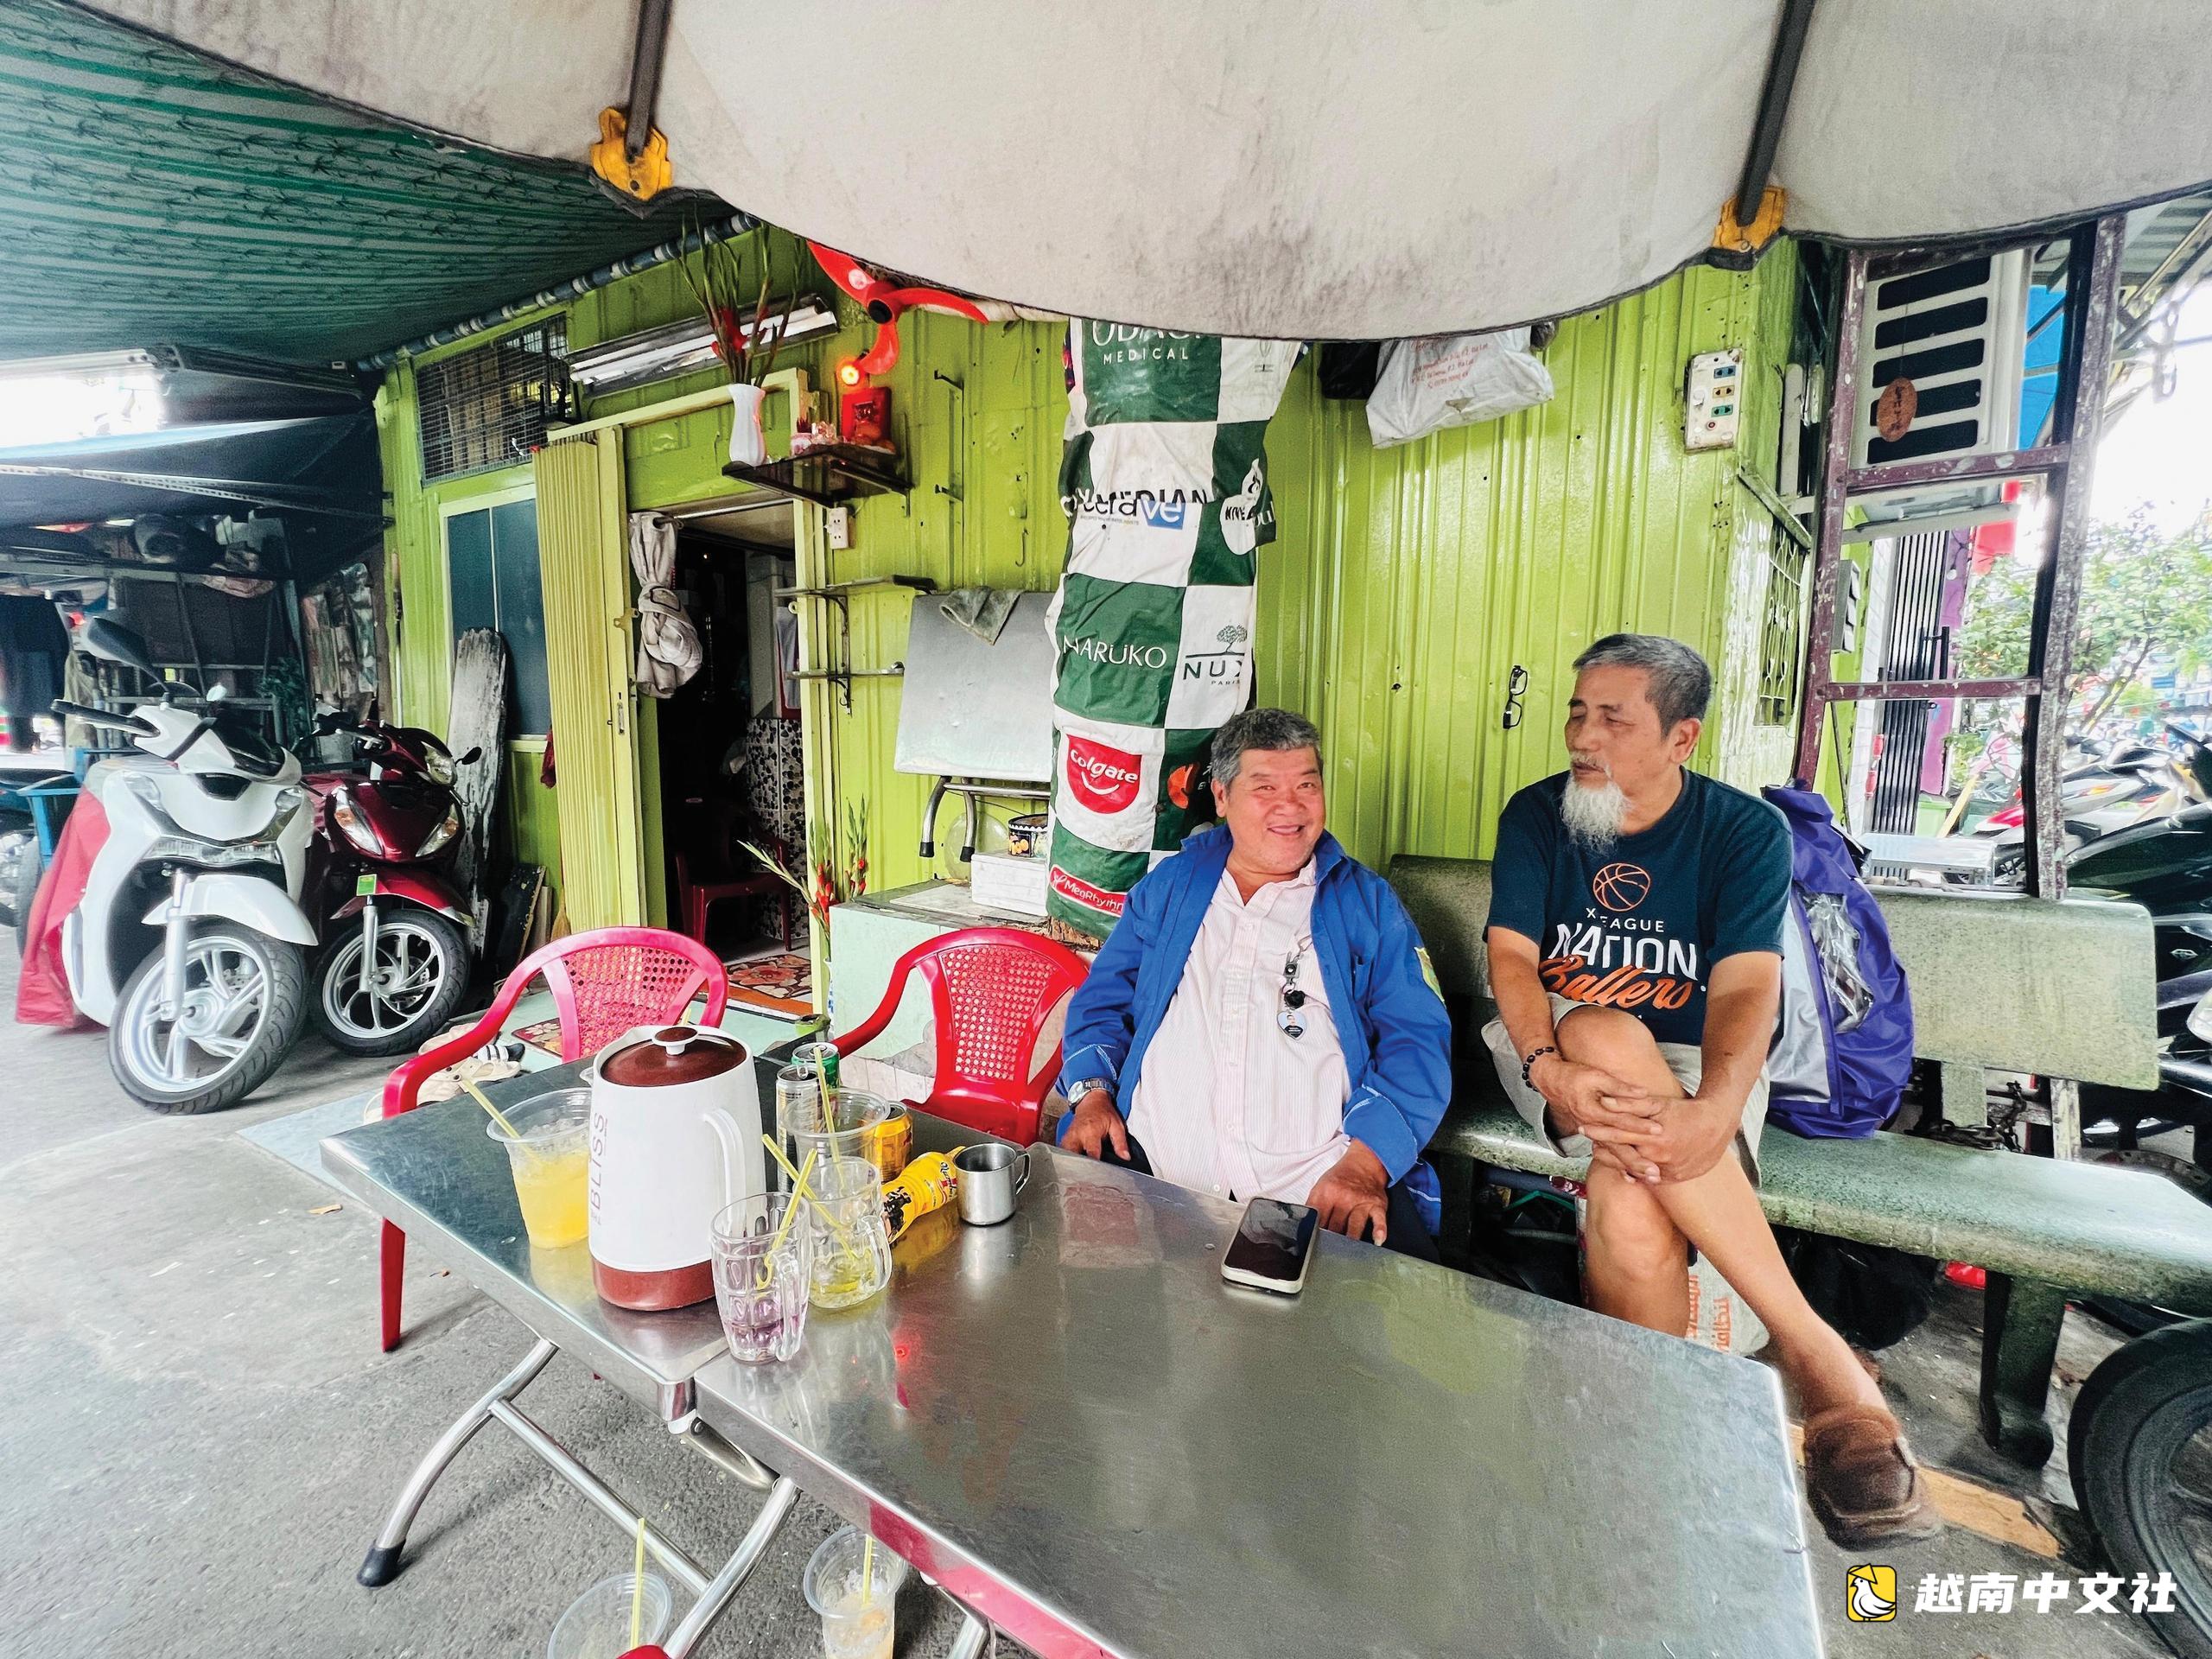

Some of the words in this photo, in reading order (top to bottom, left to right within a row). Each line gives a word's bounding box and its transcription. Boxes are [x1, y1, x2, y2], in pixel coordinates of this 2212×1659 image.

[1103, 347, 1189, 365] MEDICAL
[1070, 749, 1139, 784] Colgate
[1548, 922, 1699, 982] NATION
[1538, 954, 1694, 1010] Ballers
[590, 1112, 606, 1210] BLISS
